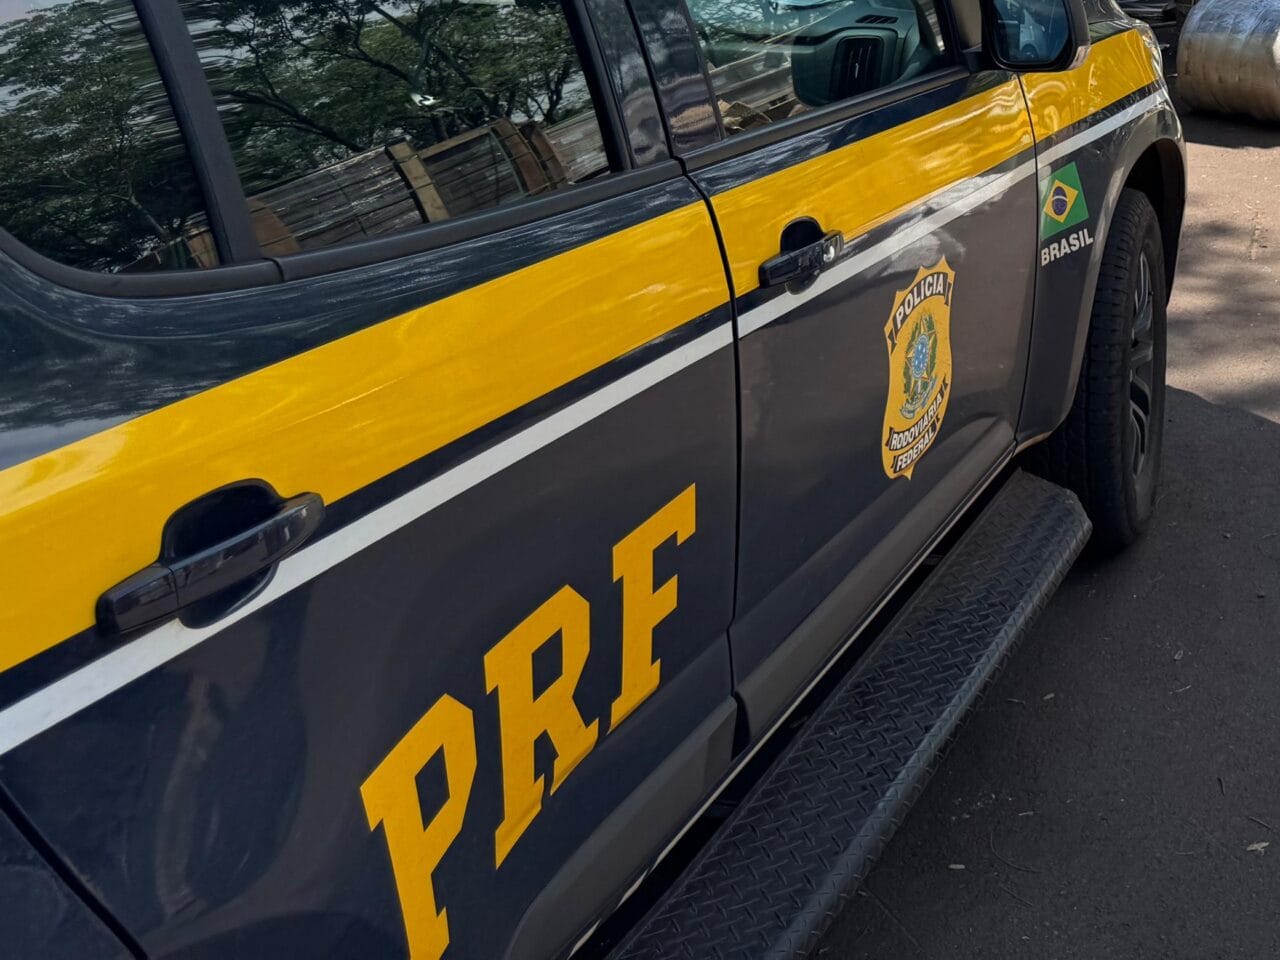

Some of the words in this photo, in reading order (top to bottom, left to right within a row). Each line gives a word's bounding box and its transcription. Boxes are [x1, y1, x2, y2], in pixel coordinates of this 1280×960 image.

[1041, 228, 1094, 267] BRASIL
[895, 273, 944, 328] POLÍCIA
[897, 427, 934, 471] FEDERAL
[360, 483, 696, 960] PRF
